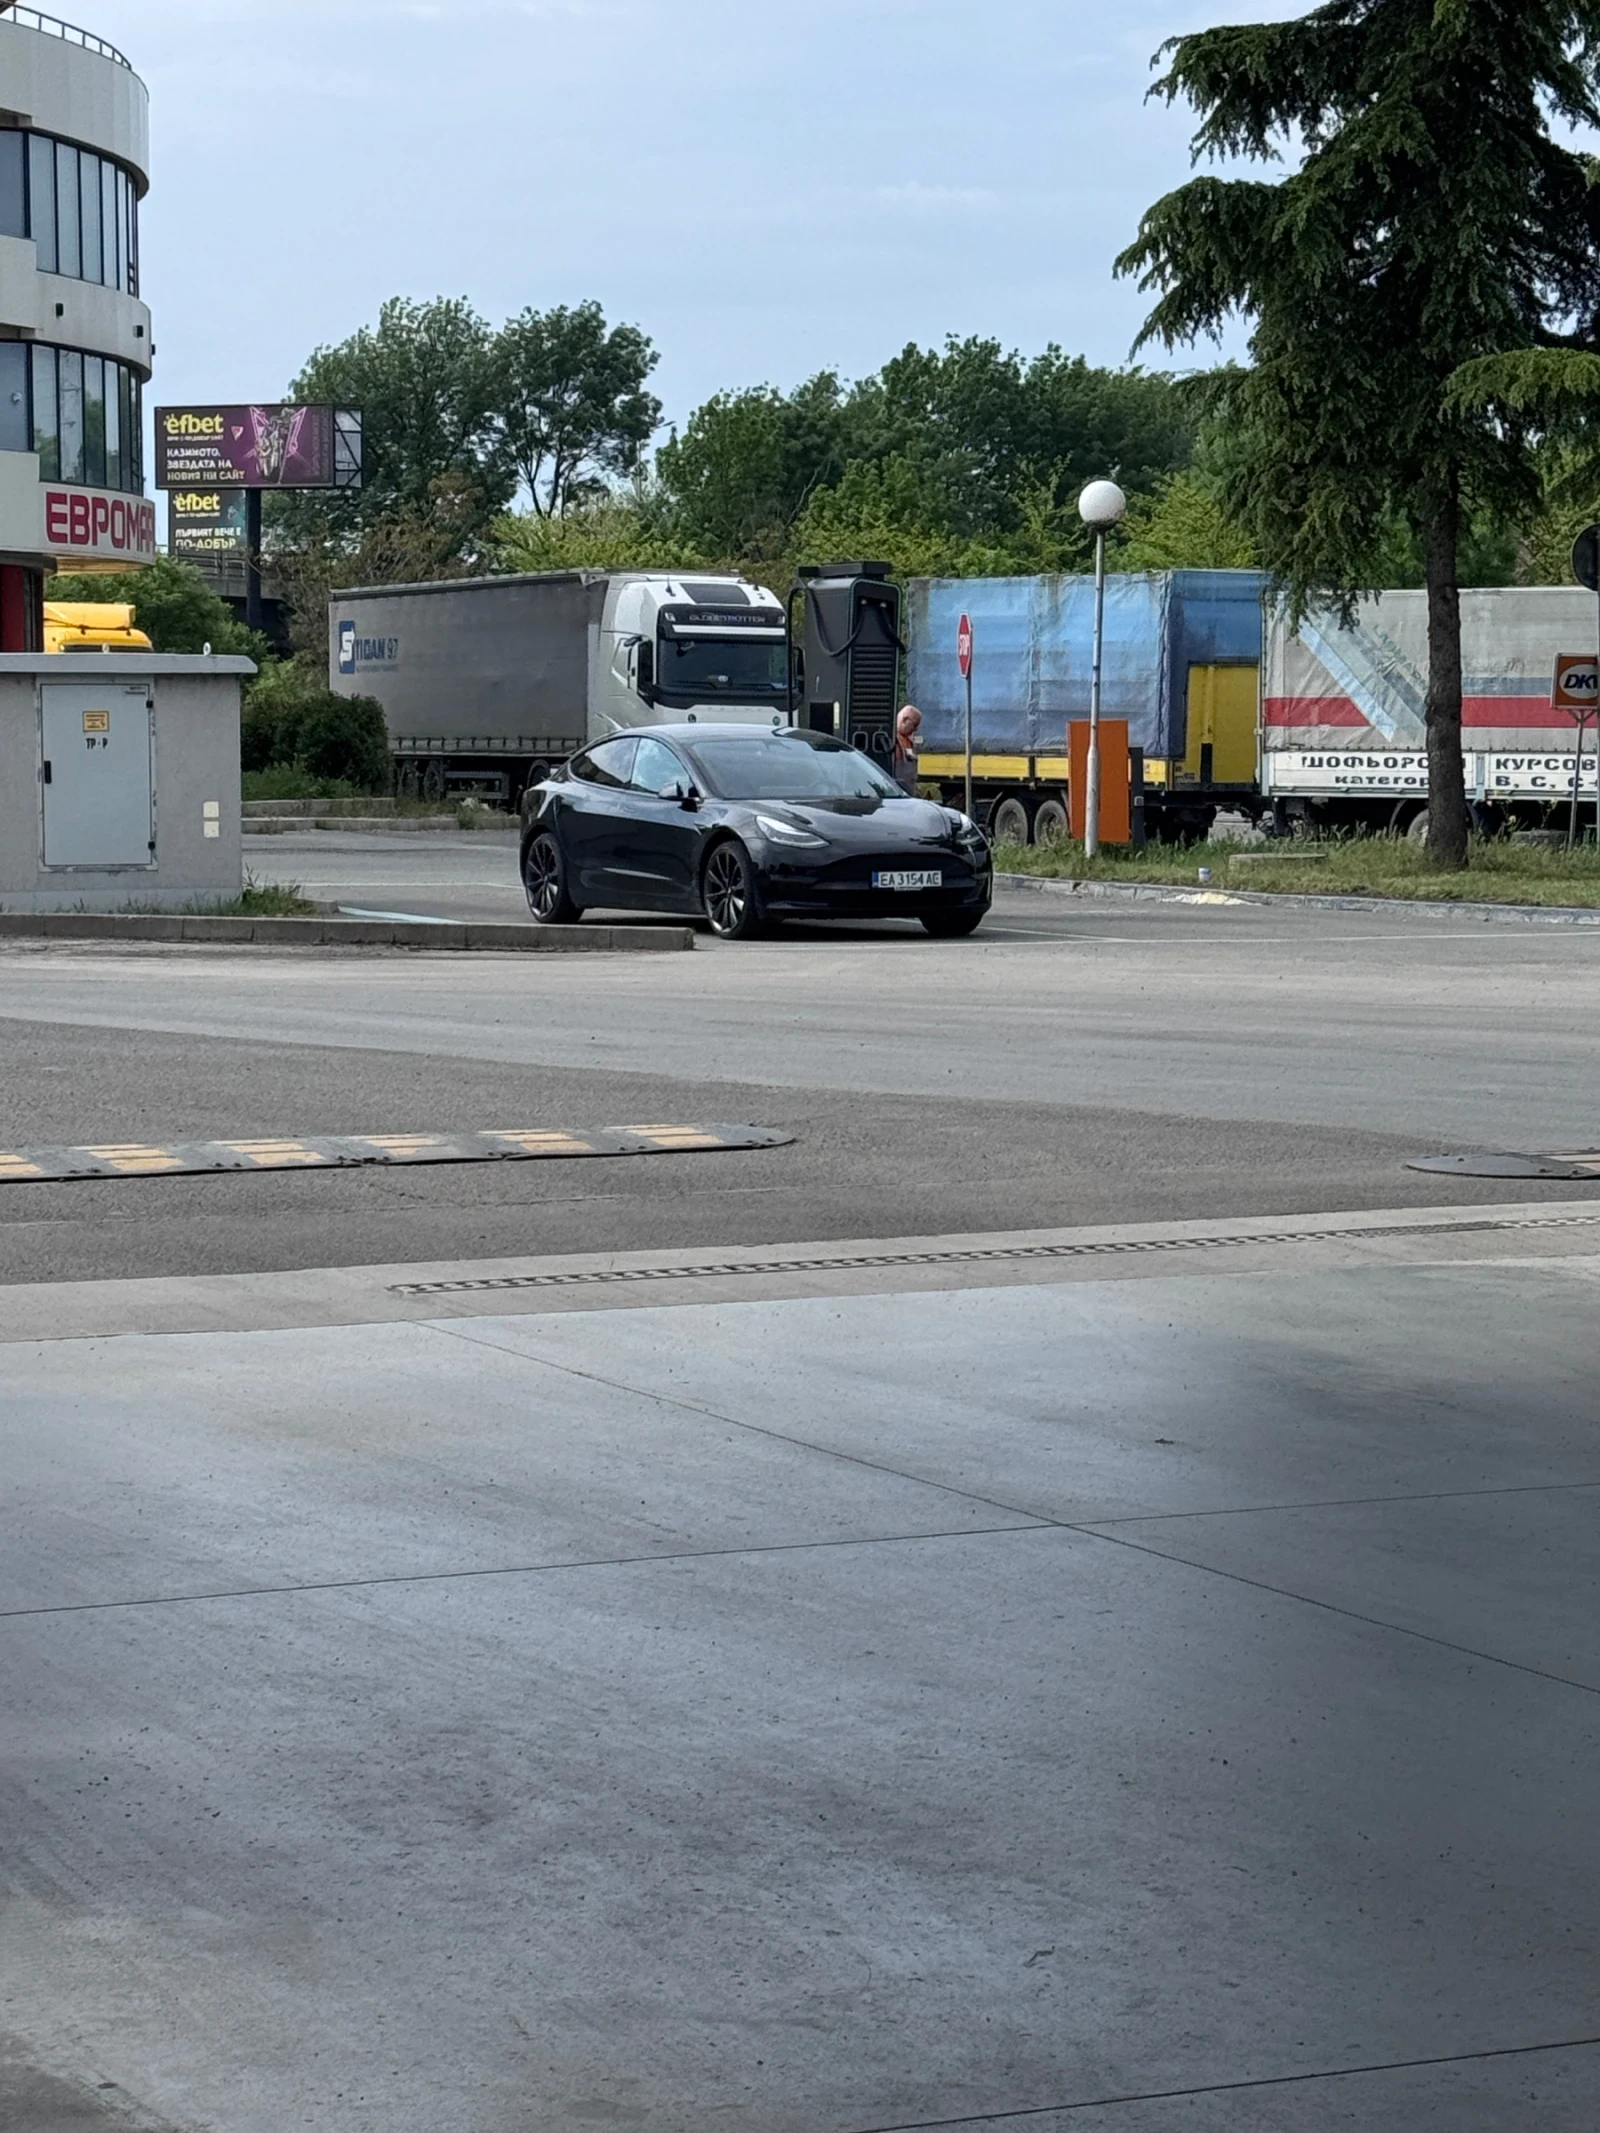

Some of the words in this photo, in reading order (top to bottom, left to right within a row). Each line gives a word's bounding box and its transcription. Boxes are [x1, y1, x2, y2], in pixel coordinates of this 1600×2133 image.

[165, 413, 224, 434] efbet
[166, 460, 216, 469] ЗВЕЗДАТА
[218, 460, 232, 468] НА
[203, 471, 217, 479] НИ
[219, 469, 245, 479] САЙТ
[175, 493, 220, 511] efbet
[880, 873, 895, 886] EA
[897, 873, 924, 885] 3154
